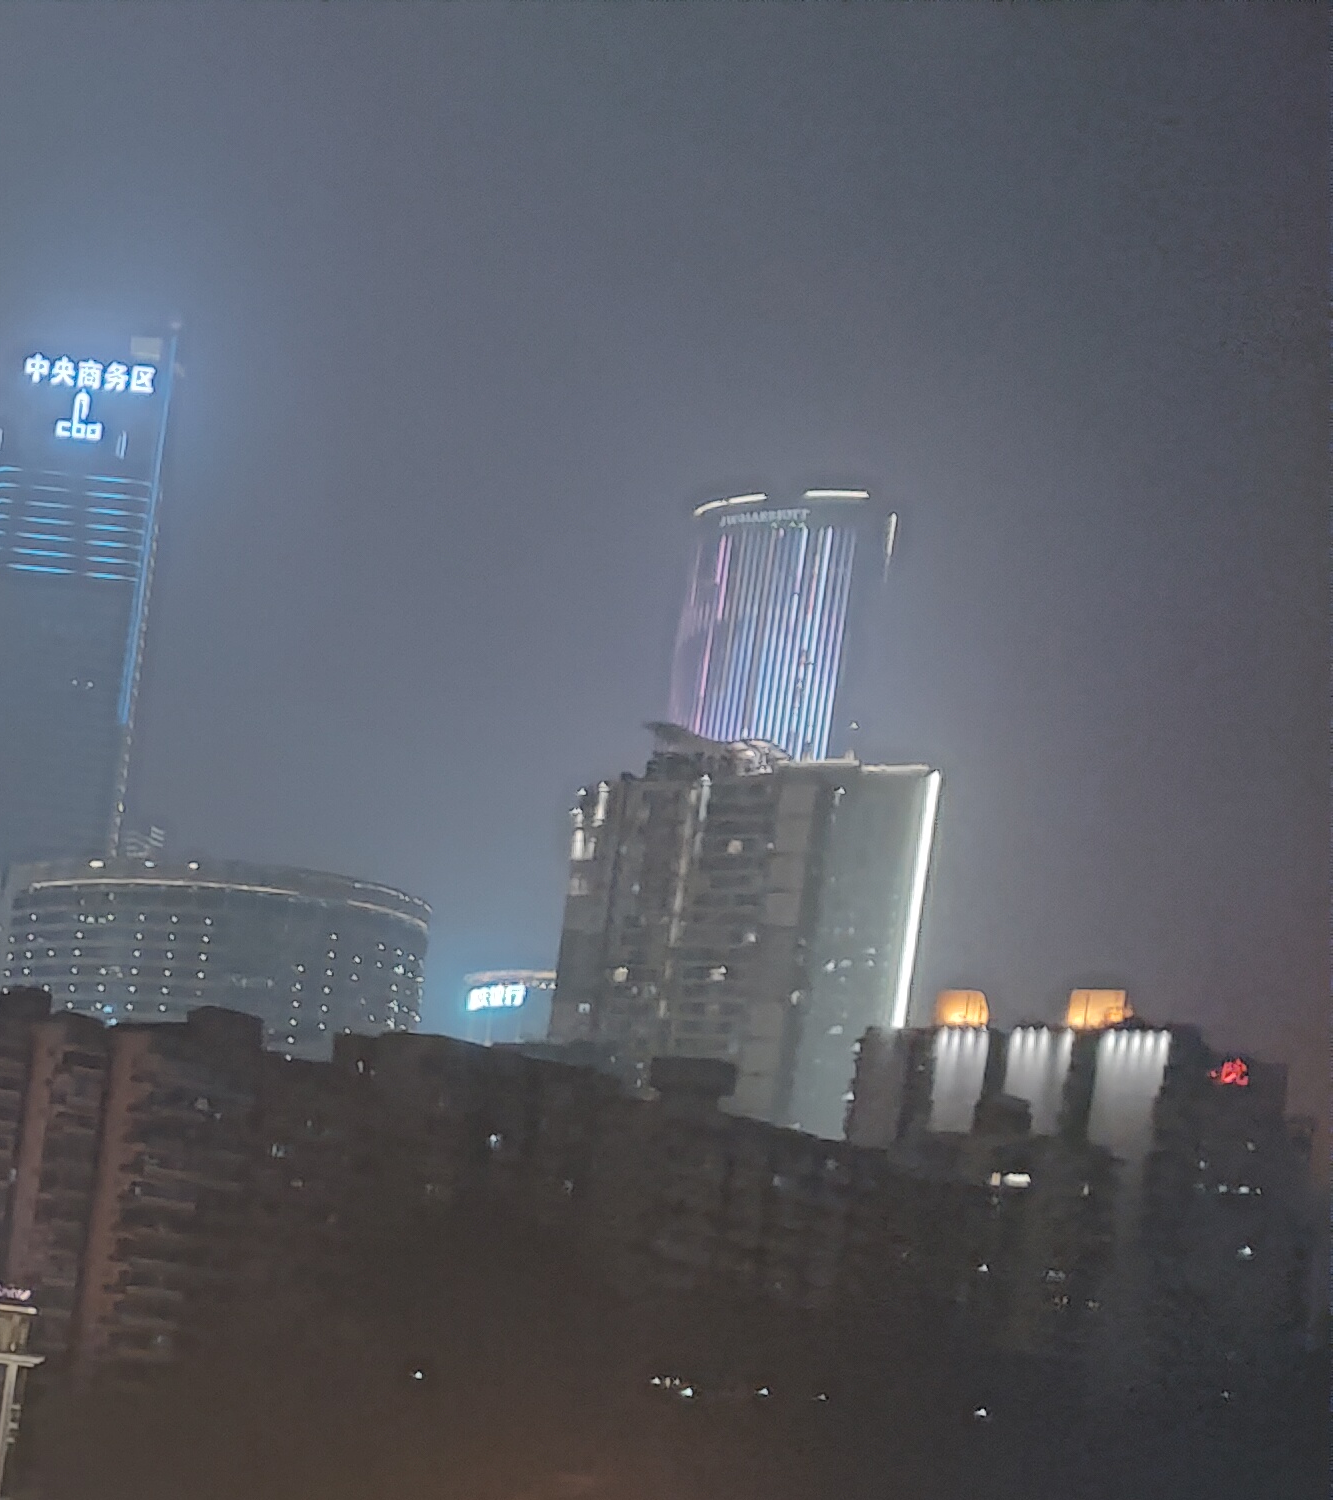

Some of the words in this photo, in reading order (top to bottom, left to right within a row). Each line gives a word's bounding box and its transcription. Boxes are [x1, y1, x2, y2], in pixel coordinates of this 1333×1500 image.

[24, 352, 156, 393] 中央商务区
